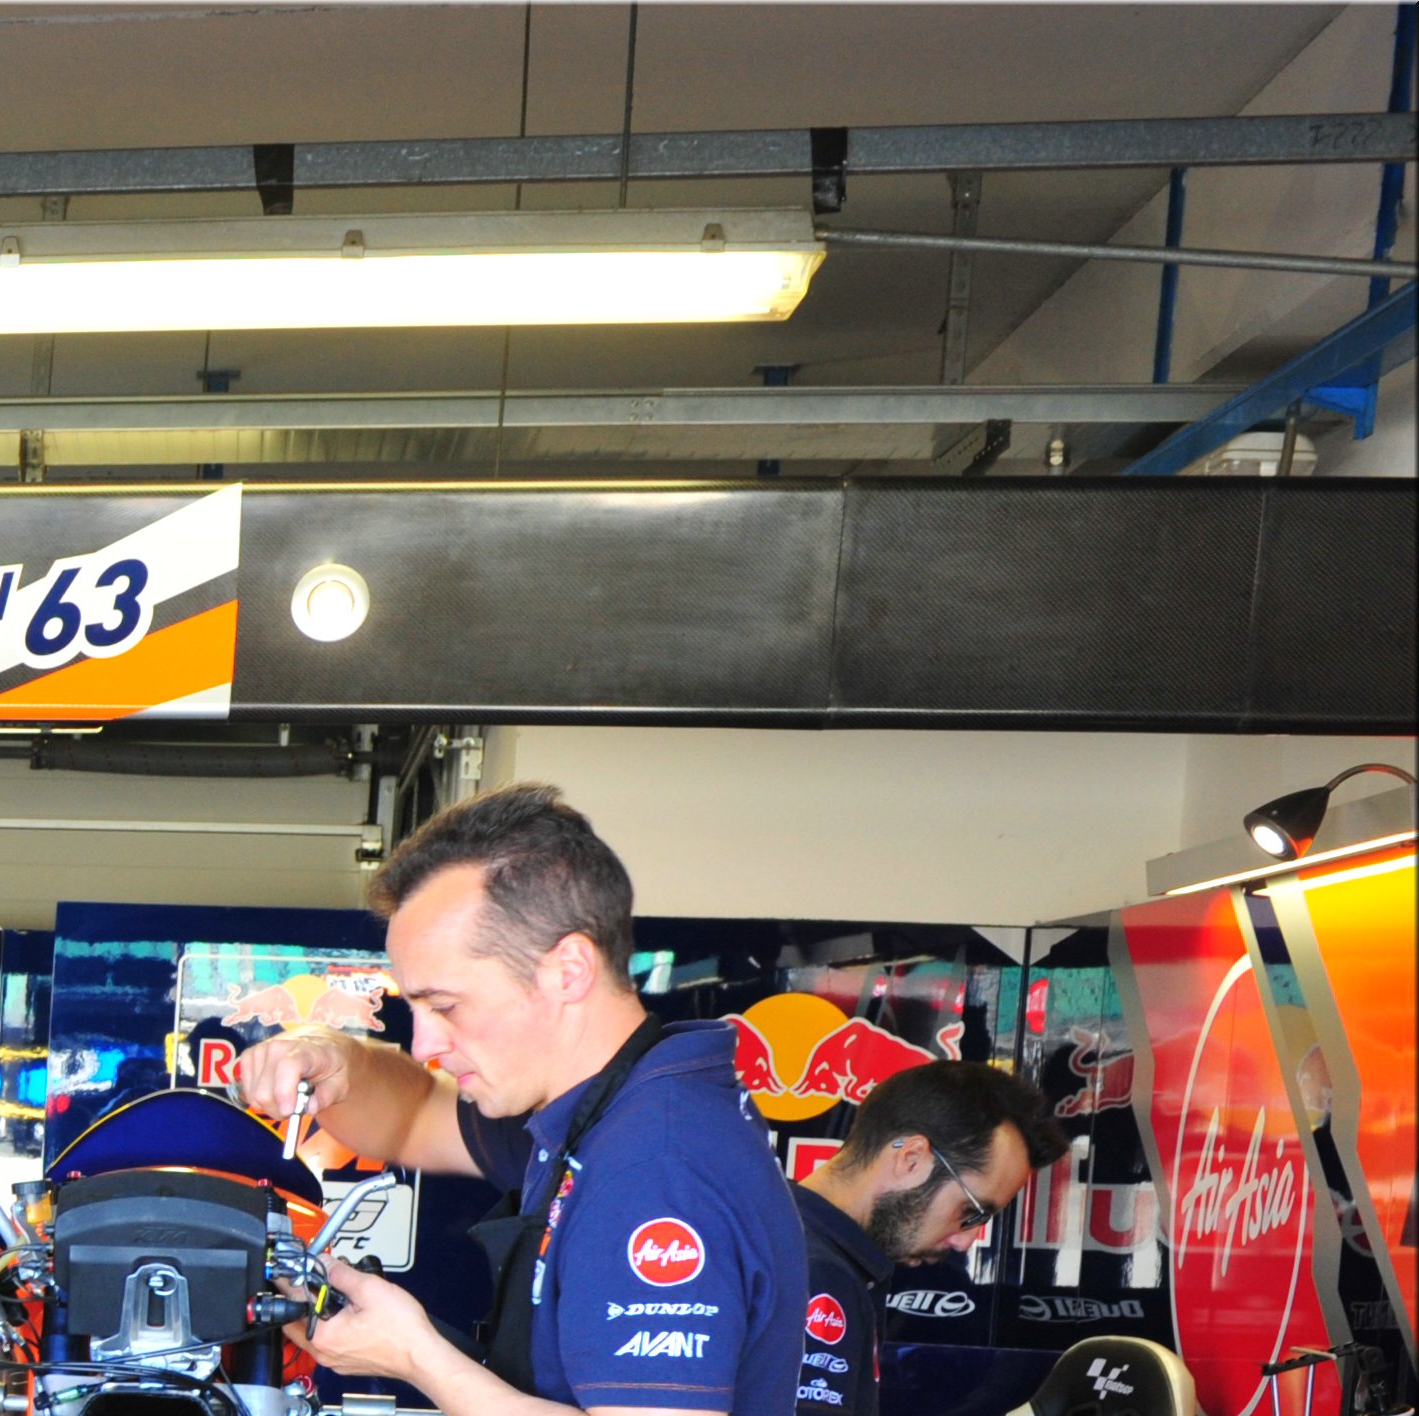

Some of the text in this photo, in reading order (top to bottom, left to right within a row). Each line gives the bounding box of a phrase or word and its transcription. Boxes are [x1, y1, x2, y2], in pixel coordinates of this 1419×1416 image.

[24, 557, 149, 658] 63
[623, 1302, 720, 1318] DUNLOP
[613, 1331, 711, 1358] AVANT
[796, 1385, 844, 1406] OTOREX
